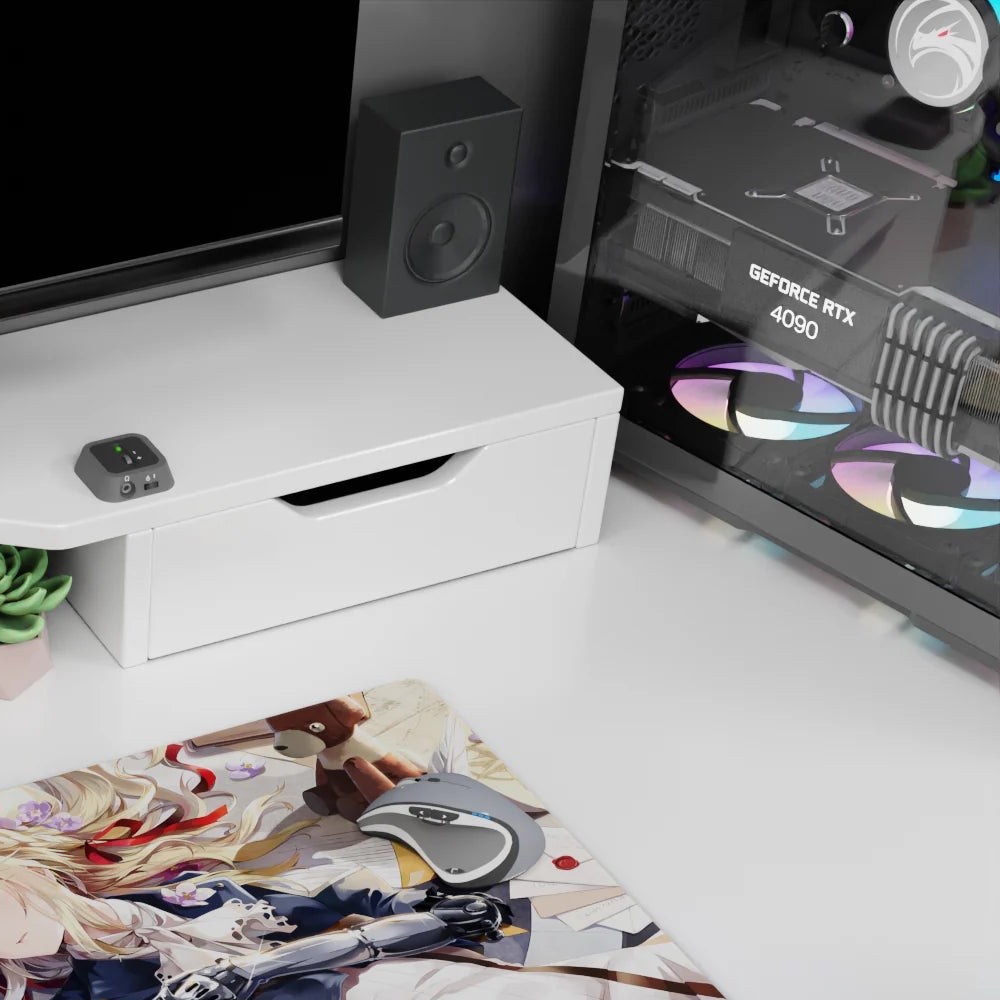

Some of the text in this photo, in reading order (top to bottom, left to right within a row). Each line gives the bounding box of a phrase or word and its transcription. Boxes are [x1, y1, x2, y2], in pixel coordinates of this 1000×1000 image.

[749, 263, 856, 327] GEFORCE RTX
[770, 305, 819, 340] 4090
